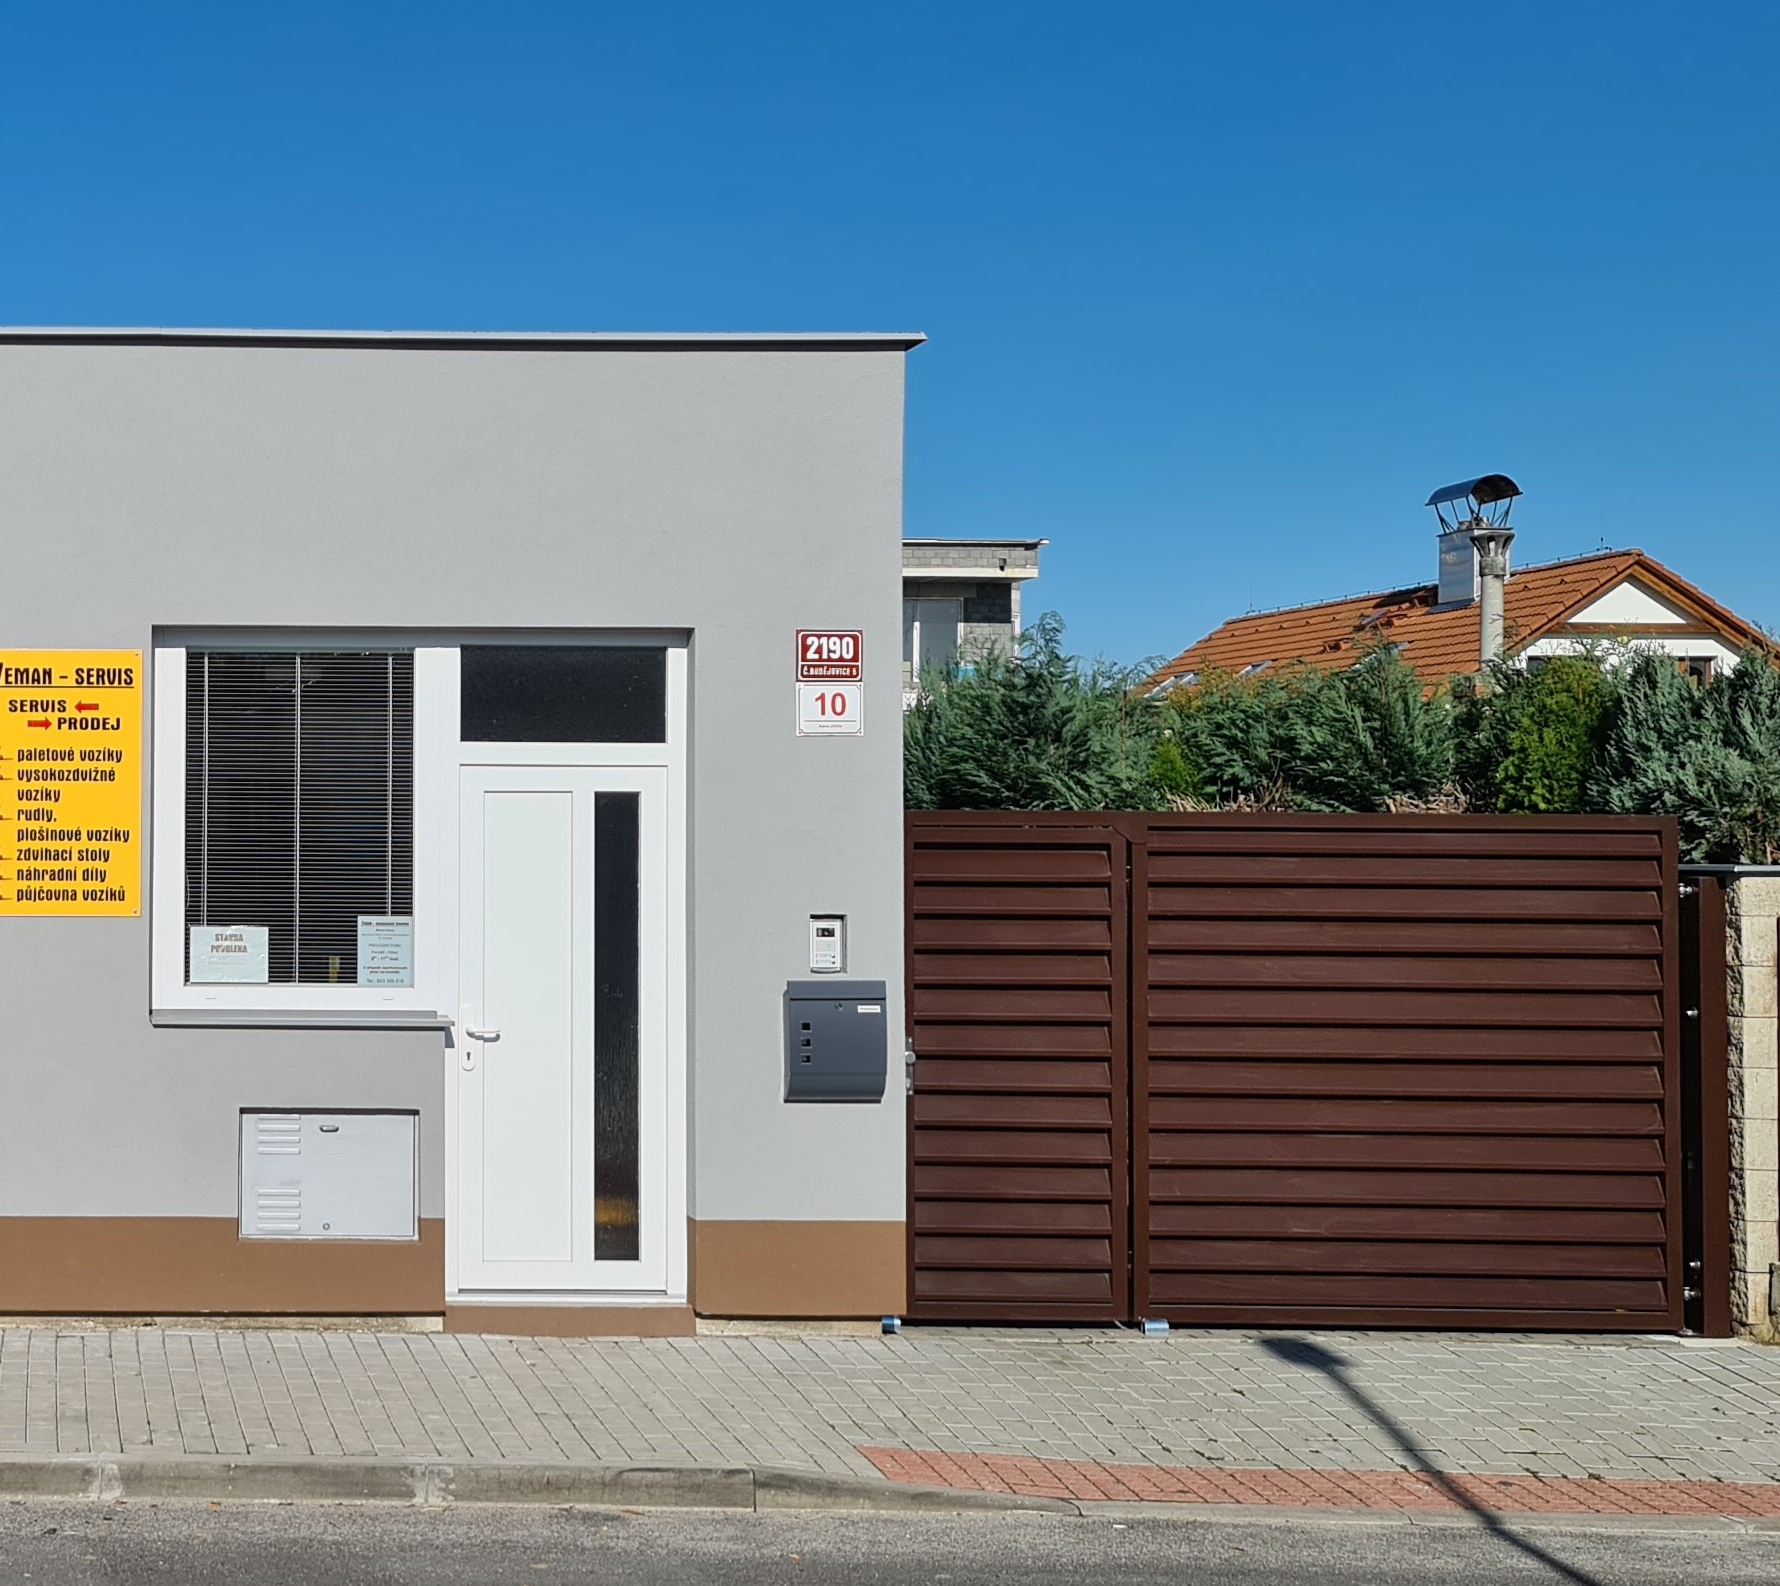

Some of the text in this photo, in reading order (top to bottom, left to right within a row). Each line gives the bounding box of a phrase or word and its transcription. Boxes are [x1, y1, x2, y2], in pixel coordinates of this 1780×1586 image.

[806, 636, 854, 660] 2190
[75, 667, 134, 686] SERVIS
[8, 699, 67, 713] SERVIS
[814, 692, 847, 716] 10
[57, 717, 121, 731] PRODEJ
[17, 747, 123, 763] paletové vozíky
[17, 767, 116, 783] vysokozdvižné
[17, 786, 61, 803] vozíky
[17, 826, 130, 843] plošinové vozíky
[16, 846, 110, 863] zdvihací stoly
[16, 866, 107, 883] náhradní díly
[16, 885, 126, 902] půjčovna vozíků
[214, 933, 244, 942] STAVBA
